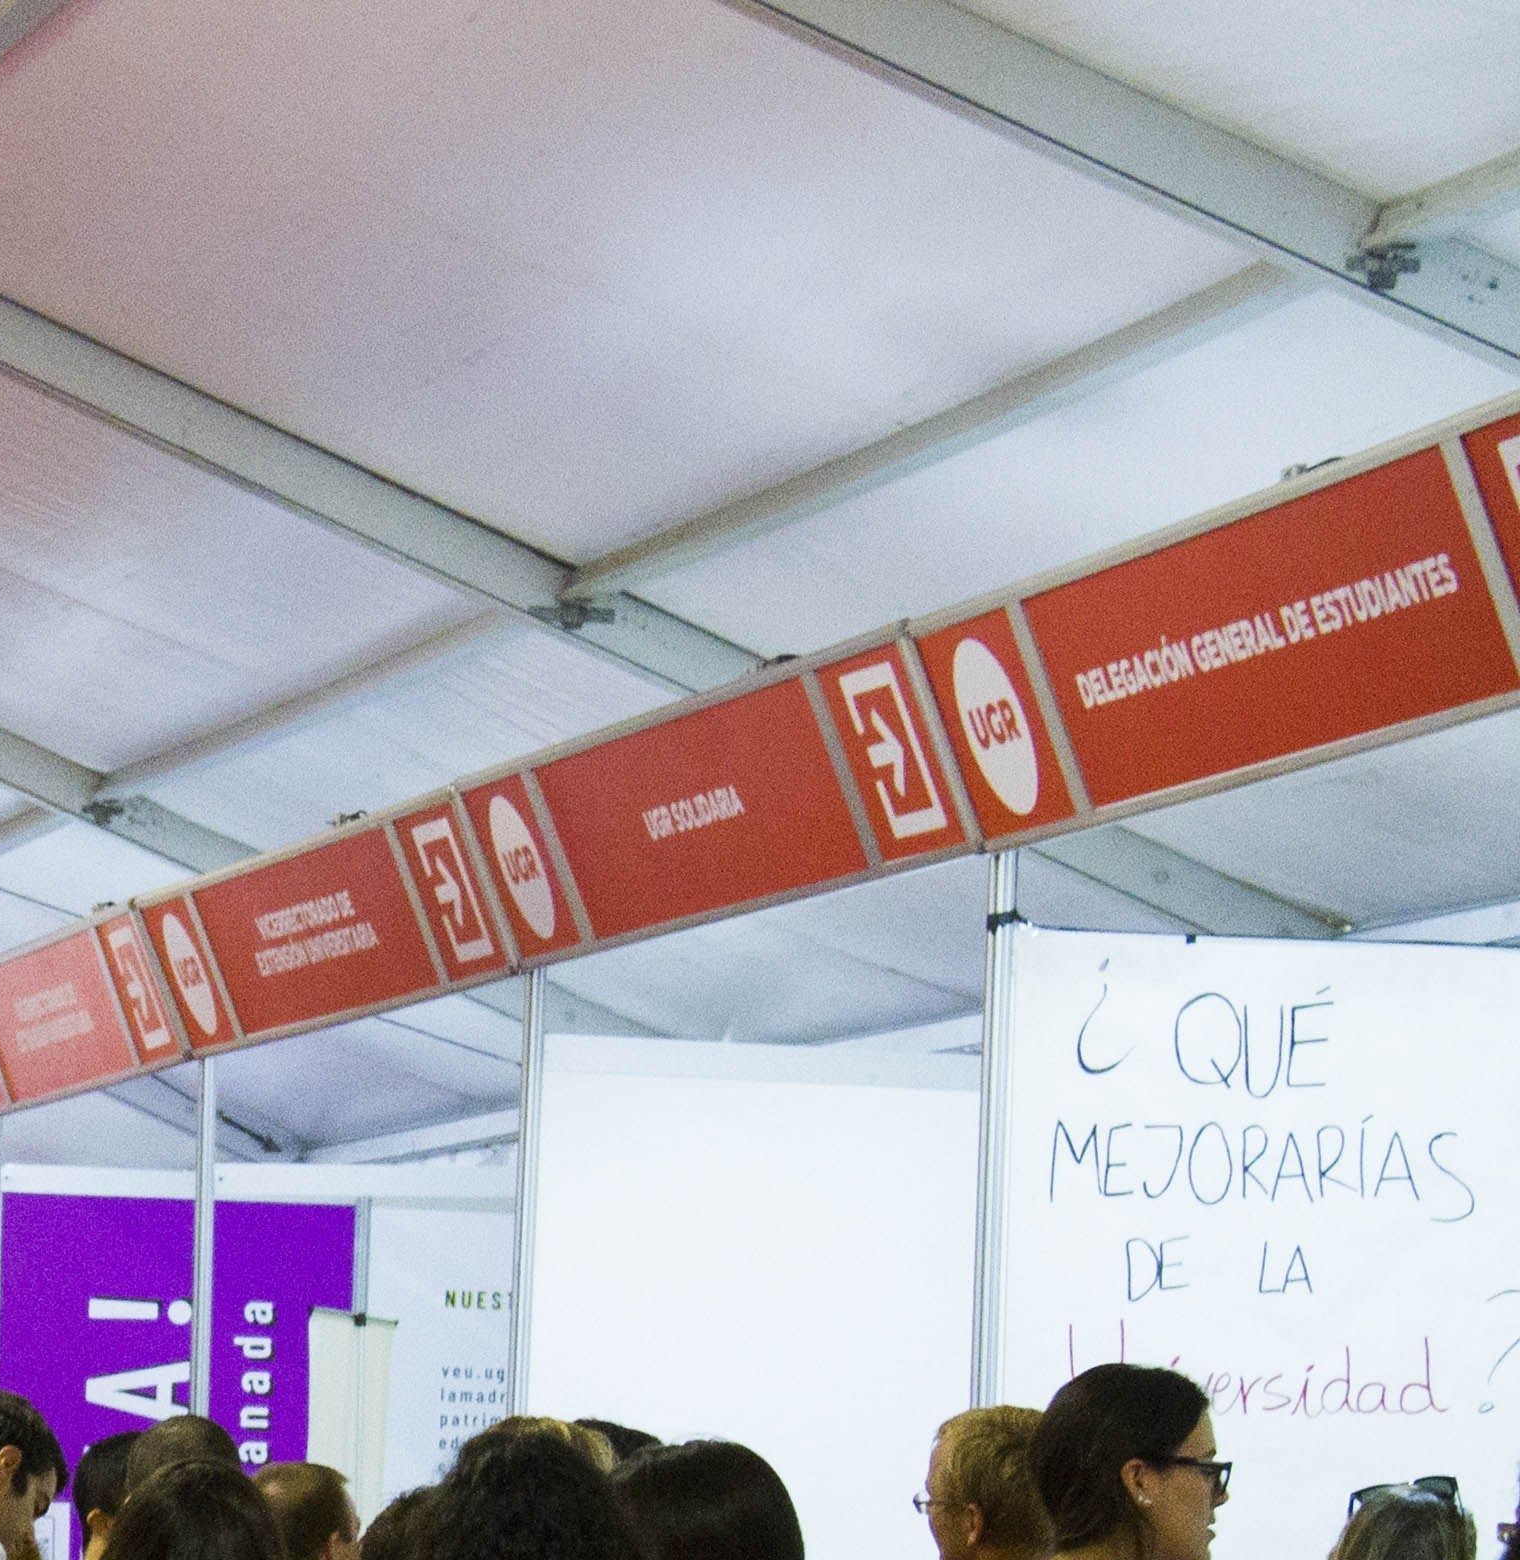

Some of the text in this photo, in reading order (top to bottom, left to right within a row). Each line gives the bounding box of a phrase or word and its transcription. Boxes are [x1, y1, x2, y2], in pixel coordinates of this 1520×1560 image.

[1074, 553, 1459, 710] DELEGACIÓN GENERAL DE ESTUDIANTES
[968, 697, 1021, 749] UGR
[642, 784, 745, 841] UGR SOLIDARIA
[503, 845, 540, 885] UGR
[1174, 985, 1335, 1098] QUÉ
[1049, 1114, 1475, 1222] MEJORARÍAS
[444, 1289, 512, 1310] NUES
[1125, 1235, 1314, 1302] DE LA
